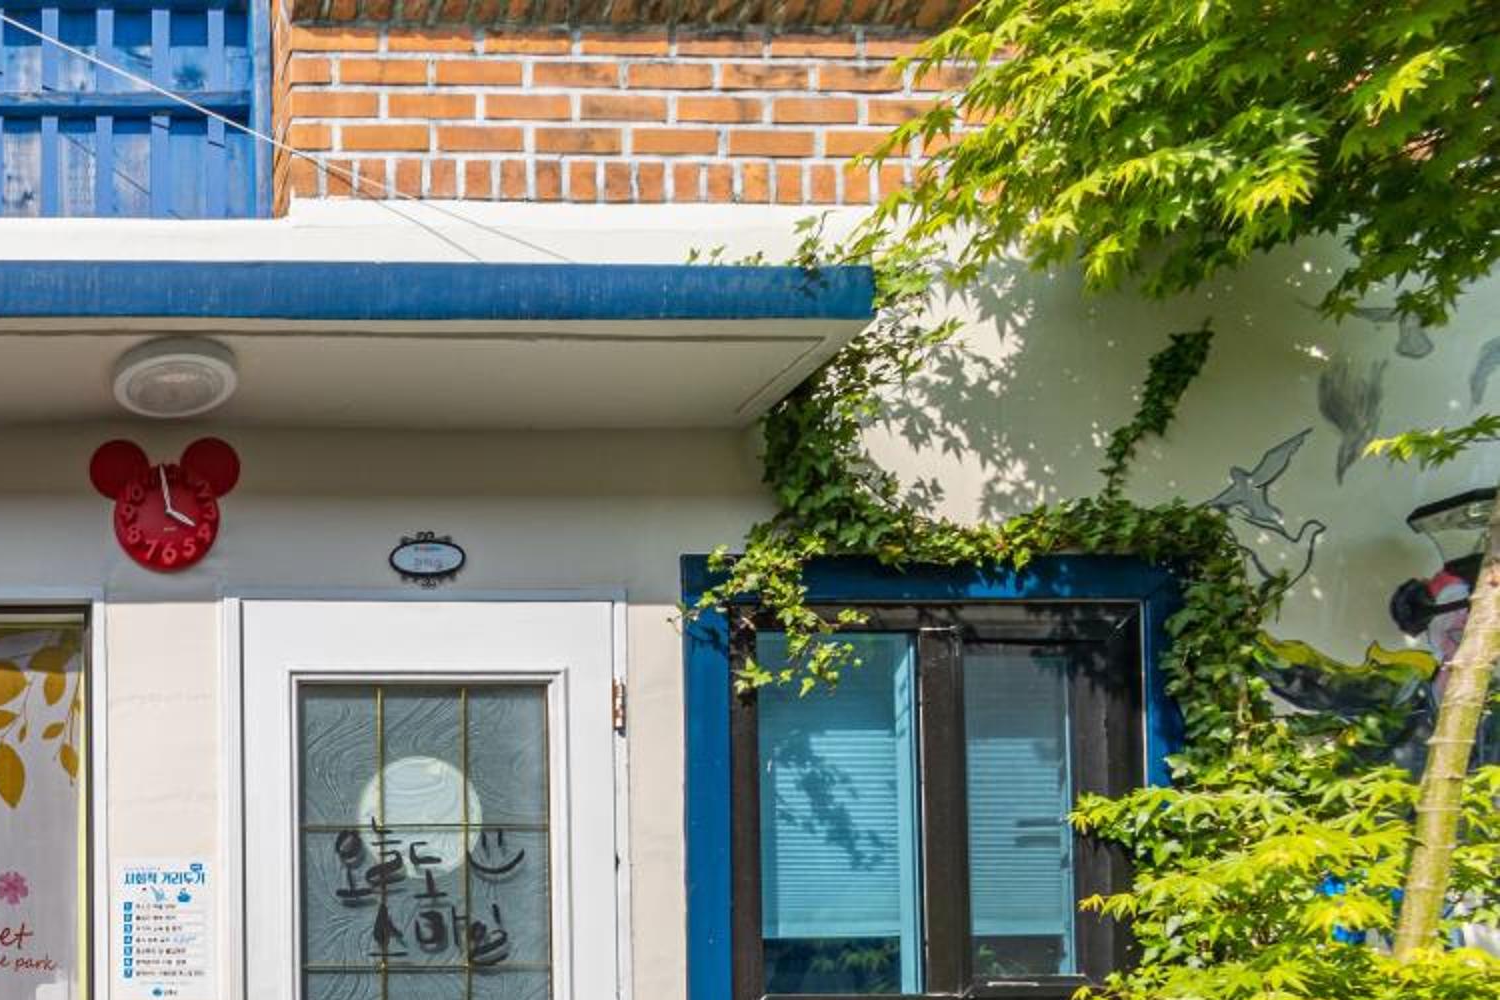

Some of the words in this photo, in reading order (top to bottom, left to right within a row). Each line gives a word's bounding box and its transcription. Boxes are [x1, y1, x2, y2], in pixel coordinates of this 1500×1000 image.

[127, 527, 141, 545] 8
[198, 522, 210, 543] 4
[146, 539, 158, 561] 7
[162, 543, 177, 565] 6
[183, 537, 197, 558] 5
[335, 816, 448, 899] 오늘도
[123, 871, 158, 885] 사회적
[161, 871, 206, 886] 거리두기
[14, 954, 57, 972] park
